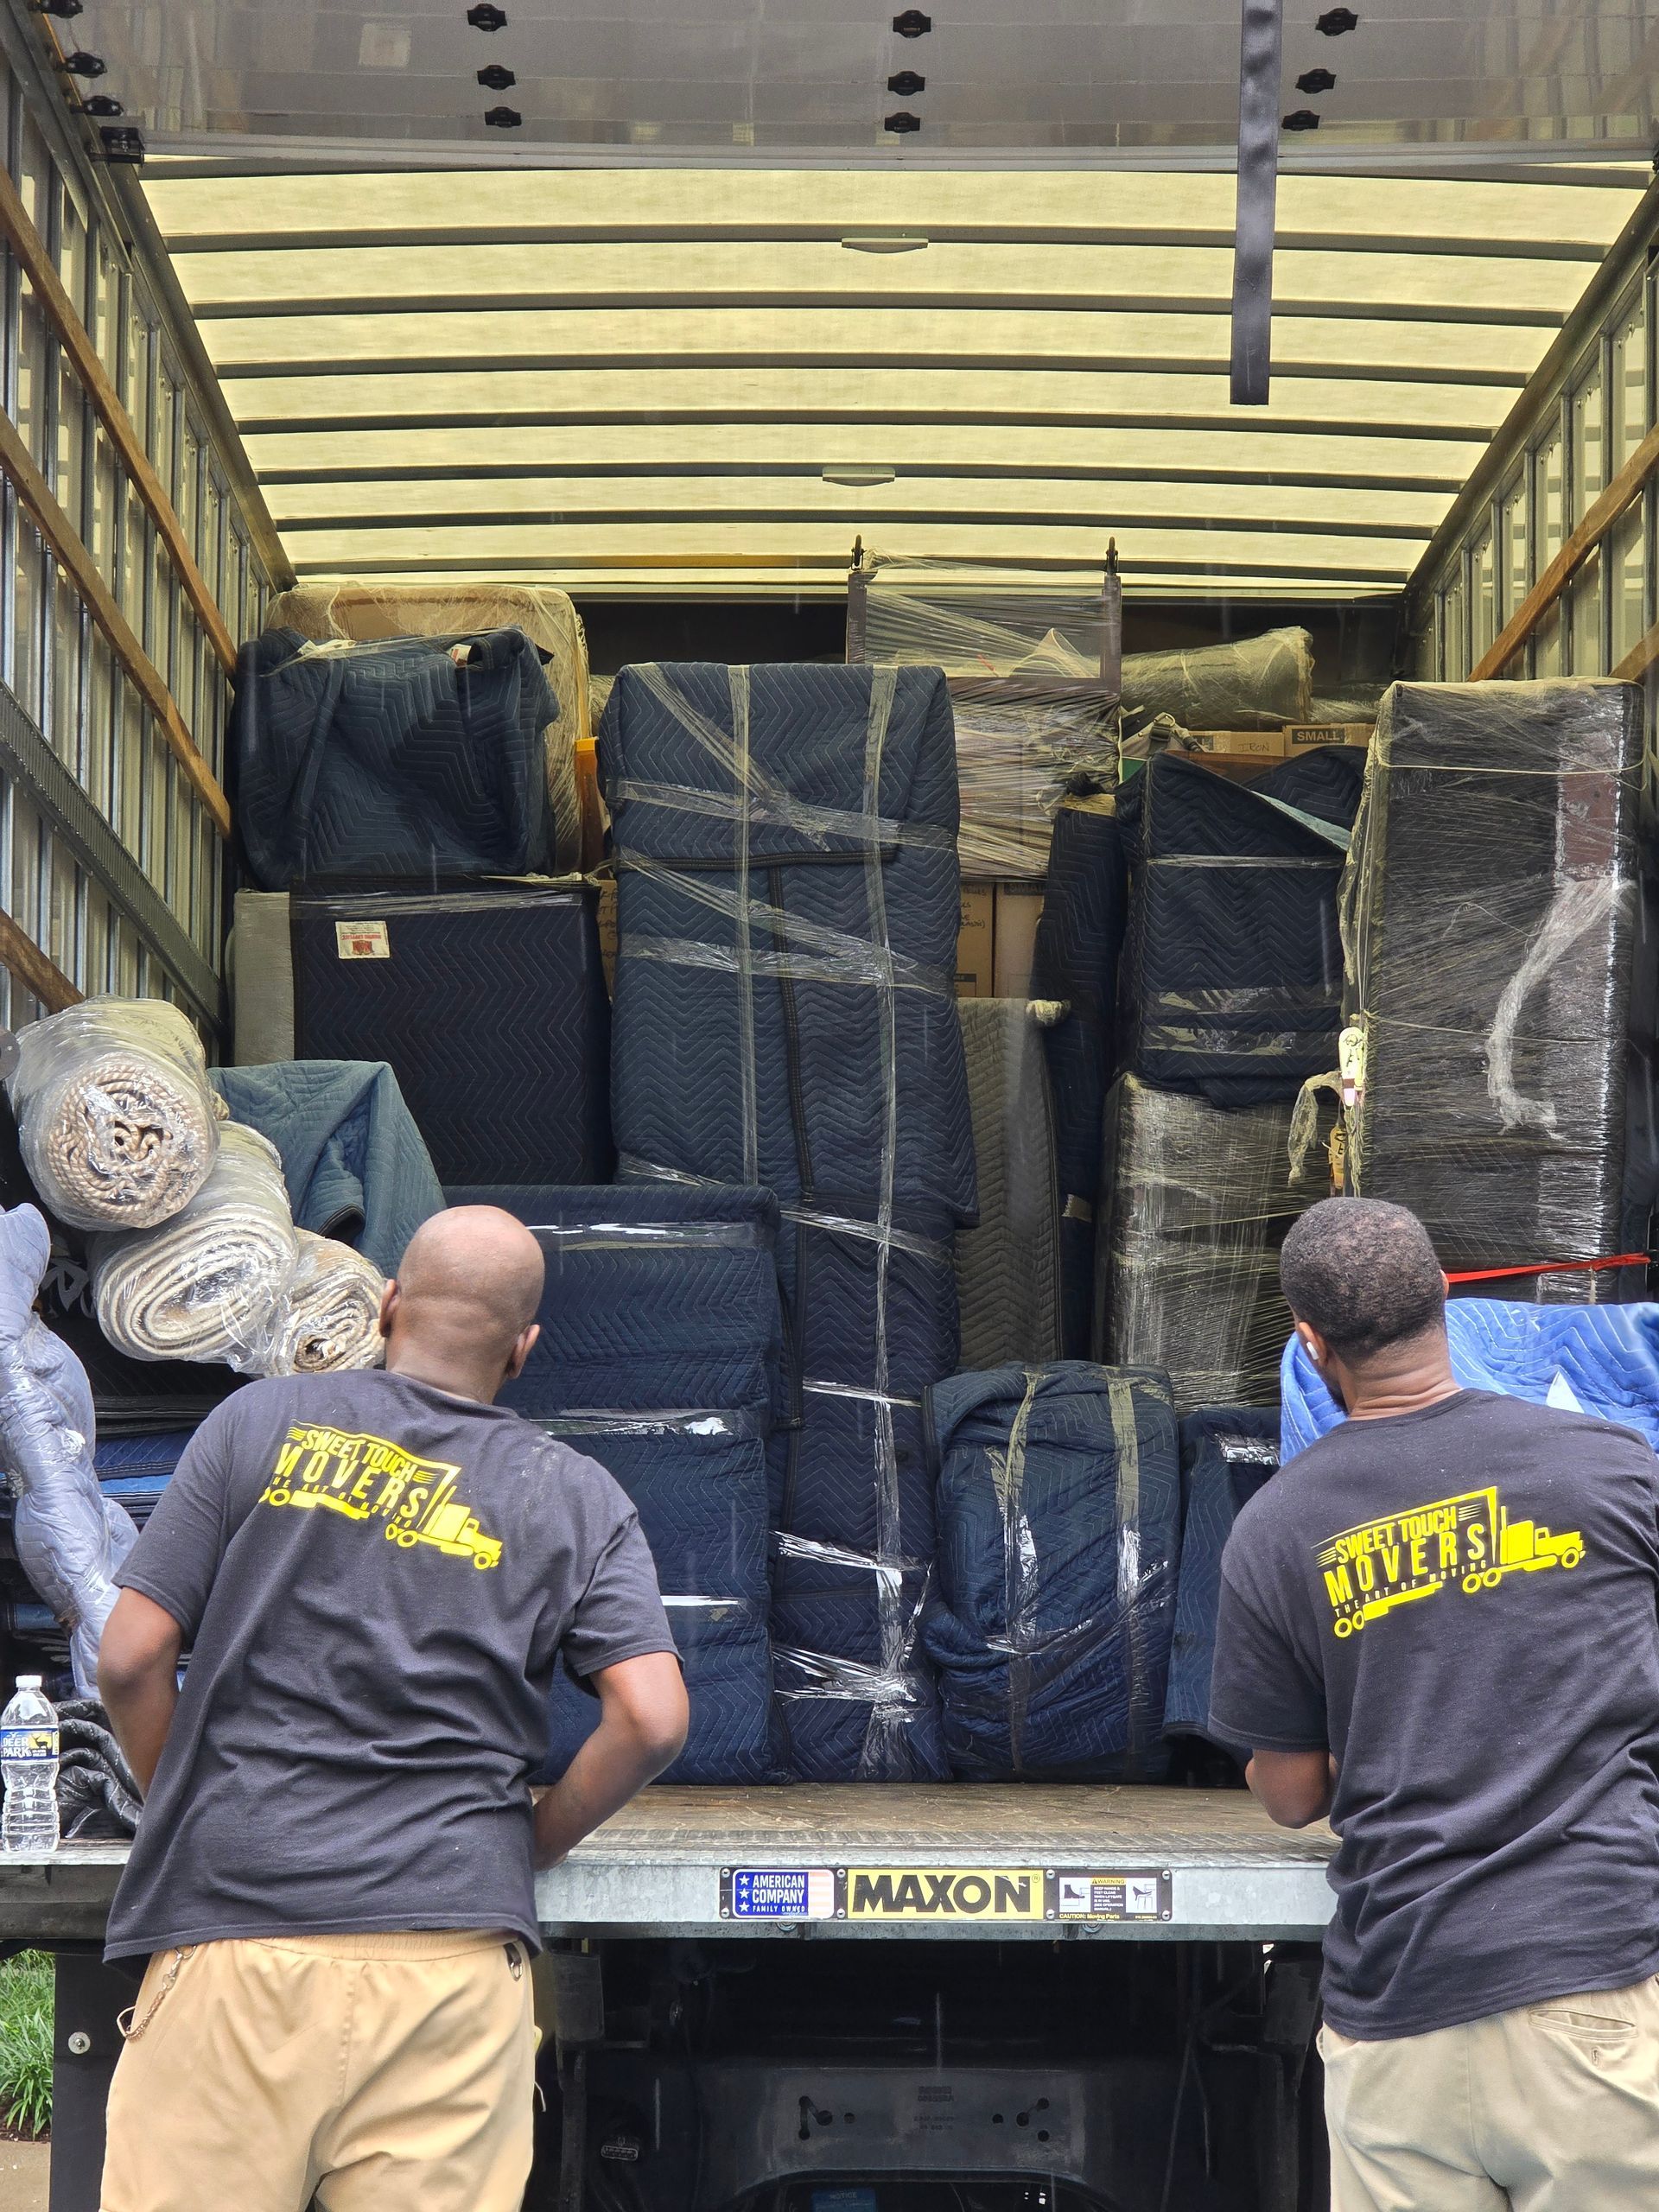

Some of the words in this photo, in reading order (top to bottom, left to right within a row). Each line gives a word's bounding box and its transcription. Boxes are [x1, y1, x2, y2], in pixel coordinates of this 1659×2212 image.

[1297, 731, 1340, 741] SMALL
[1237, 742, 1270, 753] IRON
[302, 1429, 366, 1461] SWEET
[361, 1442, 418, 1483] TOUCH
[272, 1476, 291, 1488] HE
[1335, 1522, 1395, 1564] SWEET
[1397, 1506, 1458, 1542] TOUCH
[1323, 1522, 1485, 1607] MOVERS
[1334, 1599, 1360, 1618] THE
[1364, 1586, 1389, 1603] ART
[1401, 1579, 1417, 1592] OF
[1429, 1560, 1486, 1583] MOVING
[3, 1737, 29, 1747] DEER
[3, 1746, 31, 1758] PARK
[752, 1874, 805, 1888] AMERICAN
[752, 1889, 804, 1904] COMPANY
[852, 1874, 1031, 1914] MAXON
